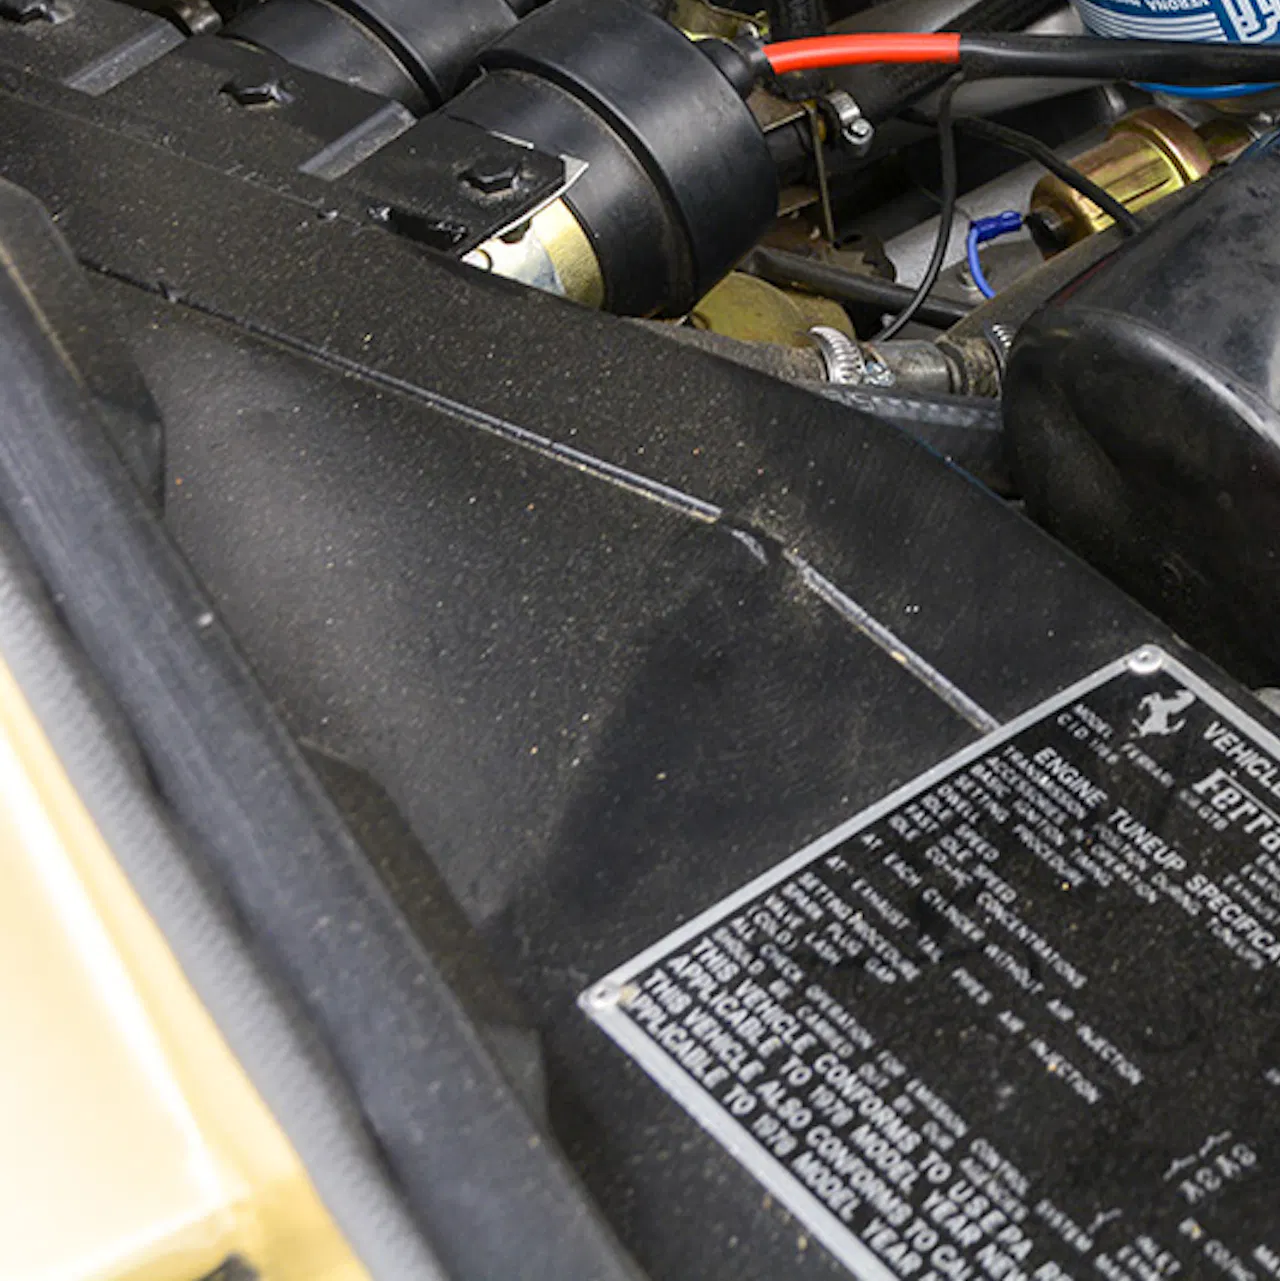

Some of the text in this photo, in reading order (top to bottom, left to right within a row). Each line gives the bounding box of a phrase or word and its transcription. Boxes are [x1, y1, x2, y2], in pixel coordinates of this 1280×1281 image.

[899, 803, 940, 835] FAST
[967, 862, 1020, 904] SPEED
[950, 773, 1014, 824] SETTING
[950, 822, 1003, 864] SPEED
[1030, 745, 1110, 809] ENGINE
[1103, 806, 1190, 876] TUNEUP
[820, 920, 867, 957] PLUG
[880, 851, 926, 887] EACH
[1069, 1022, 1149, 1086] INJECTION
[970, 889, 1092, 990] CONCENTRATIONS
[606, 982, 736, 1090] APPLICABLE
[714, 1081, 763, 1118] TO
[784, 1149, 874, 1223] MODEL
[854, 1215, 930, 1277] YEAR
[634, 967, 697, 1016] THIS
[675, 1006, 770, 1084] VEHICLE
[750, 1076, 819, 1131] ALSO
[794, 1122, 923, 1229] CONFORMS
[895, 1216, 946, 1255] TO
[659, 950, 789, 1058] APPLICABLE
[772, 1054, 818, 1089] TO
[842, 1121, 930, 1193] MODEL
[913, 1188, 989, 1250] YEAR
[684, 936, 959, 1186] THIS VEHICLE CONFORMS TO
[725, 914, 761, 942] ALL
[754, 941, 808, 985] CHECK
[798, 982, 882, 1051] OPERATION
[963, 1135, 1038, 1197] CONTROL
